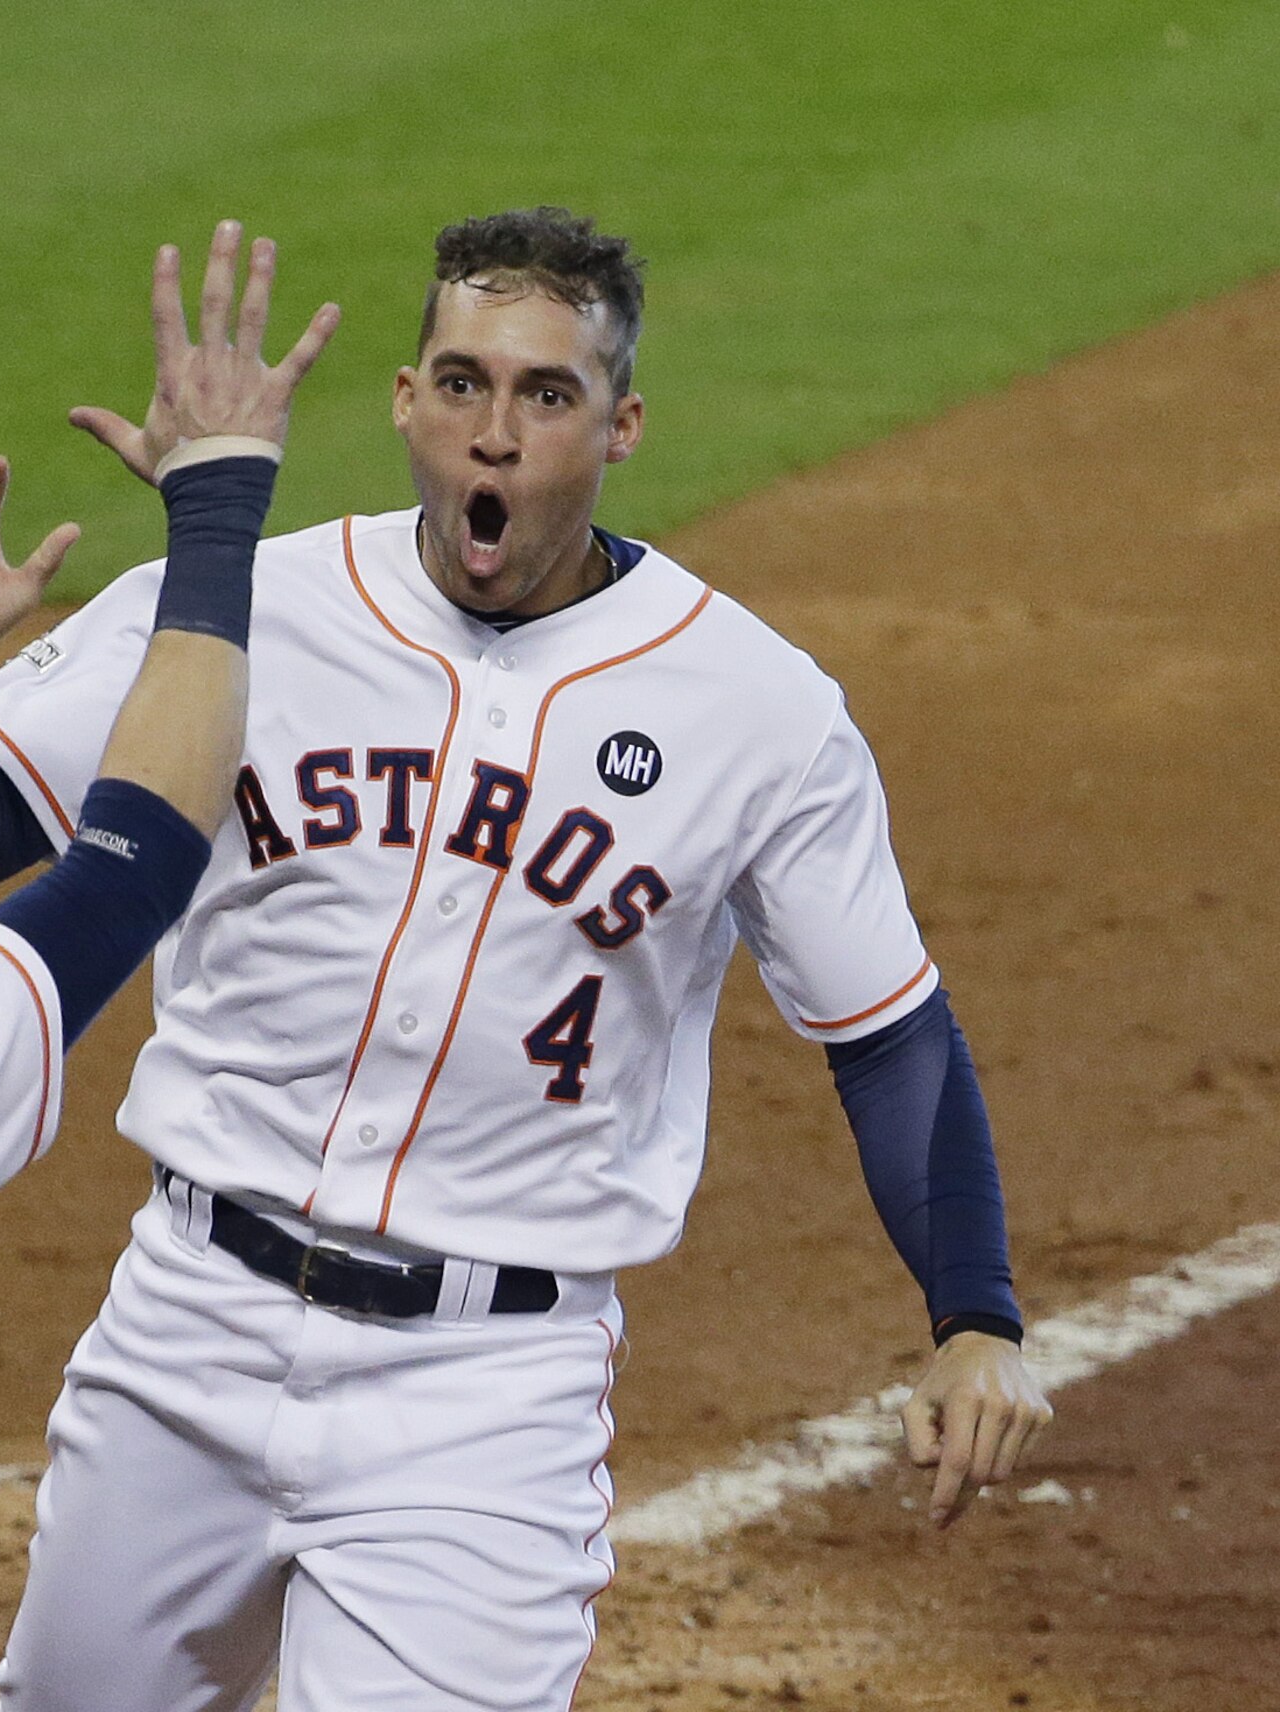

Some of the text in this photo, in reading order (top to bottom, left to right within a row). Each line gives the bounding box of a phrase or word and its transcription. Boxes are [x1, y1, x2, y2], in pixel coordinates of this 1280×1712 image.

[604, 740, 655, 785] MH
[234, 747, 673, 949] ASTROS
[522, 974, 604, 1104] 4
